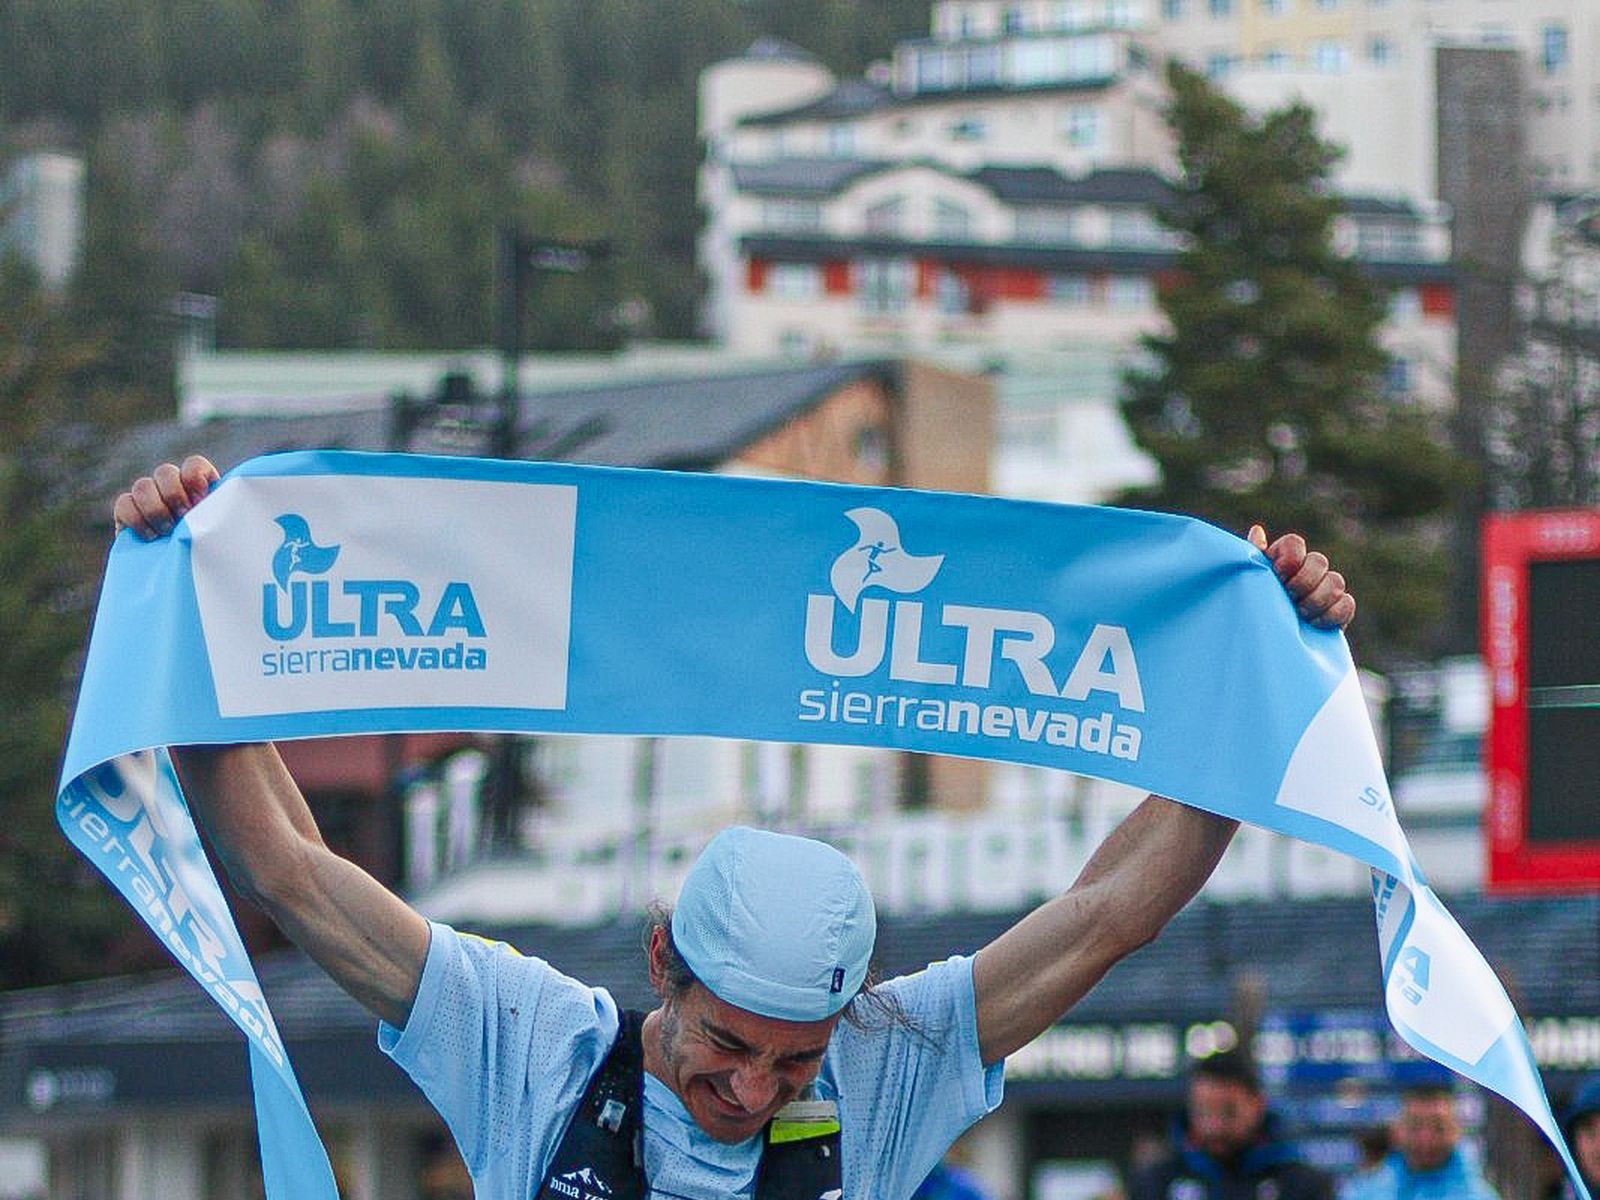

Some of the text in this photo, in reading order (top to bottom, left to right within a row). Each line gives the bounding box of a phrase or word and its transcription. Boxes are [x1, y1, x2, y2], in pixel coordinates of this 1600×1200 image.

[263, 580, 487, 641] ULTRA
[262, 642, 487, 677] sierranevada
[804, 593, 1145, 713] ULTRA
[798, 679, 1143, 762] sierranevada
